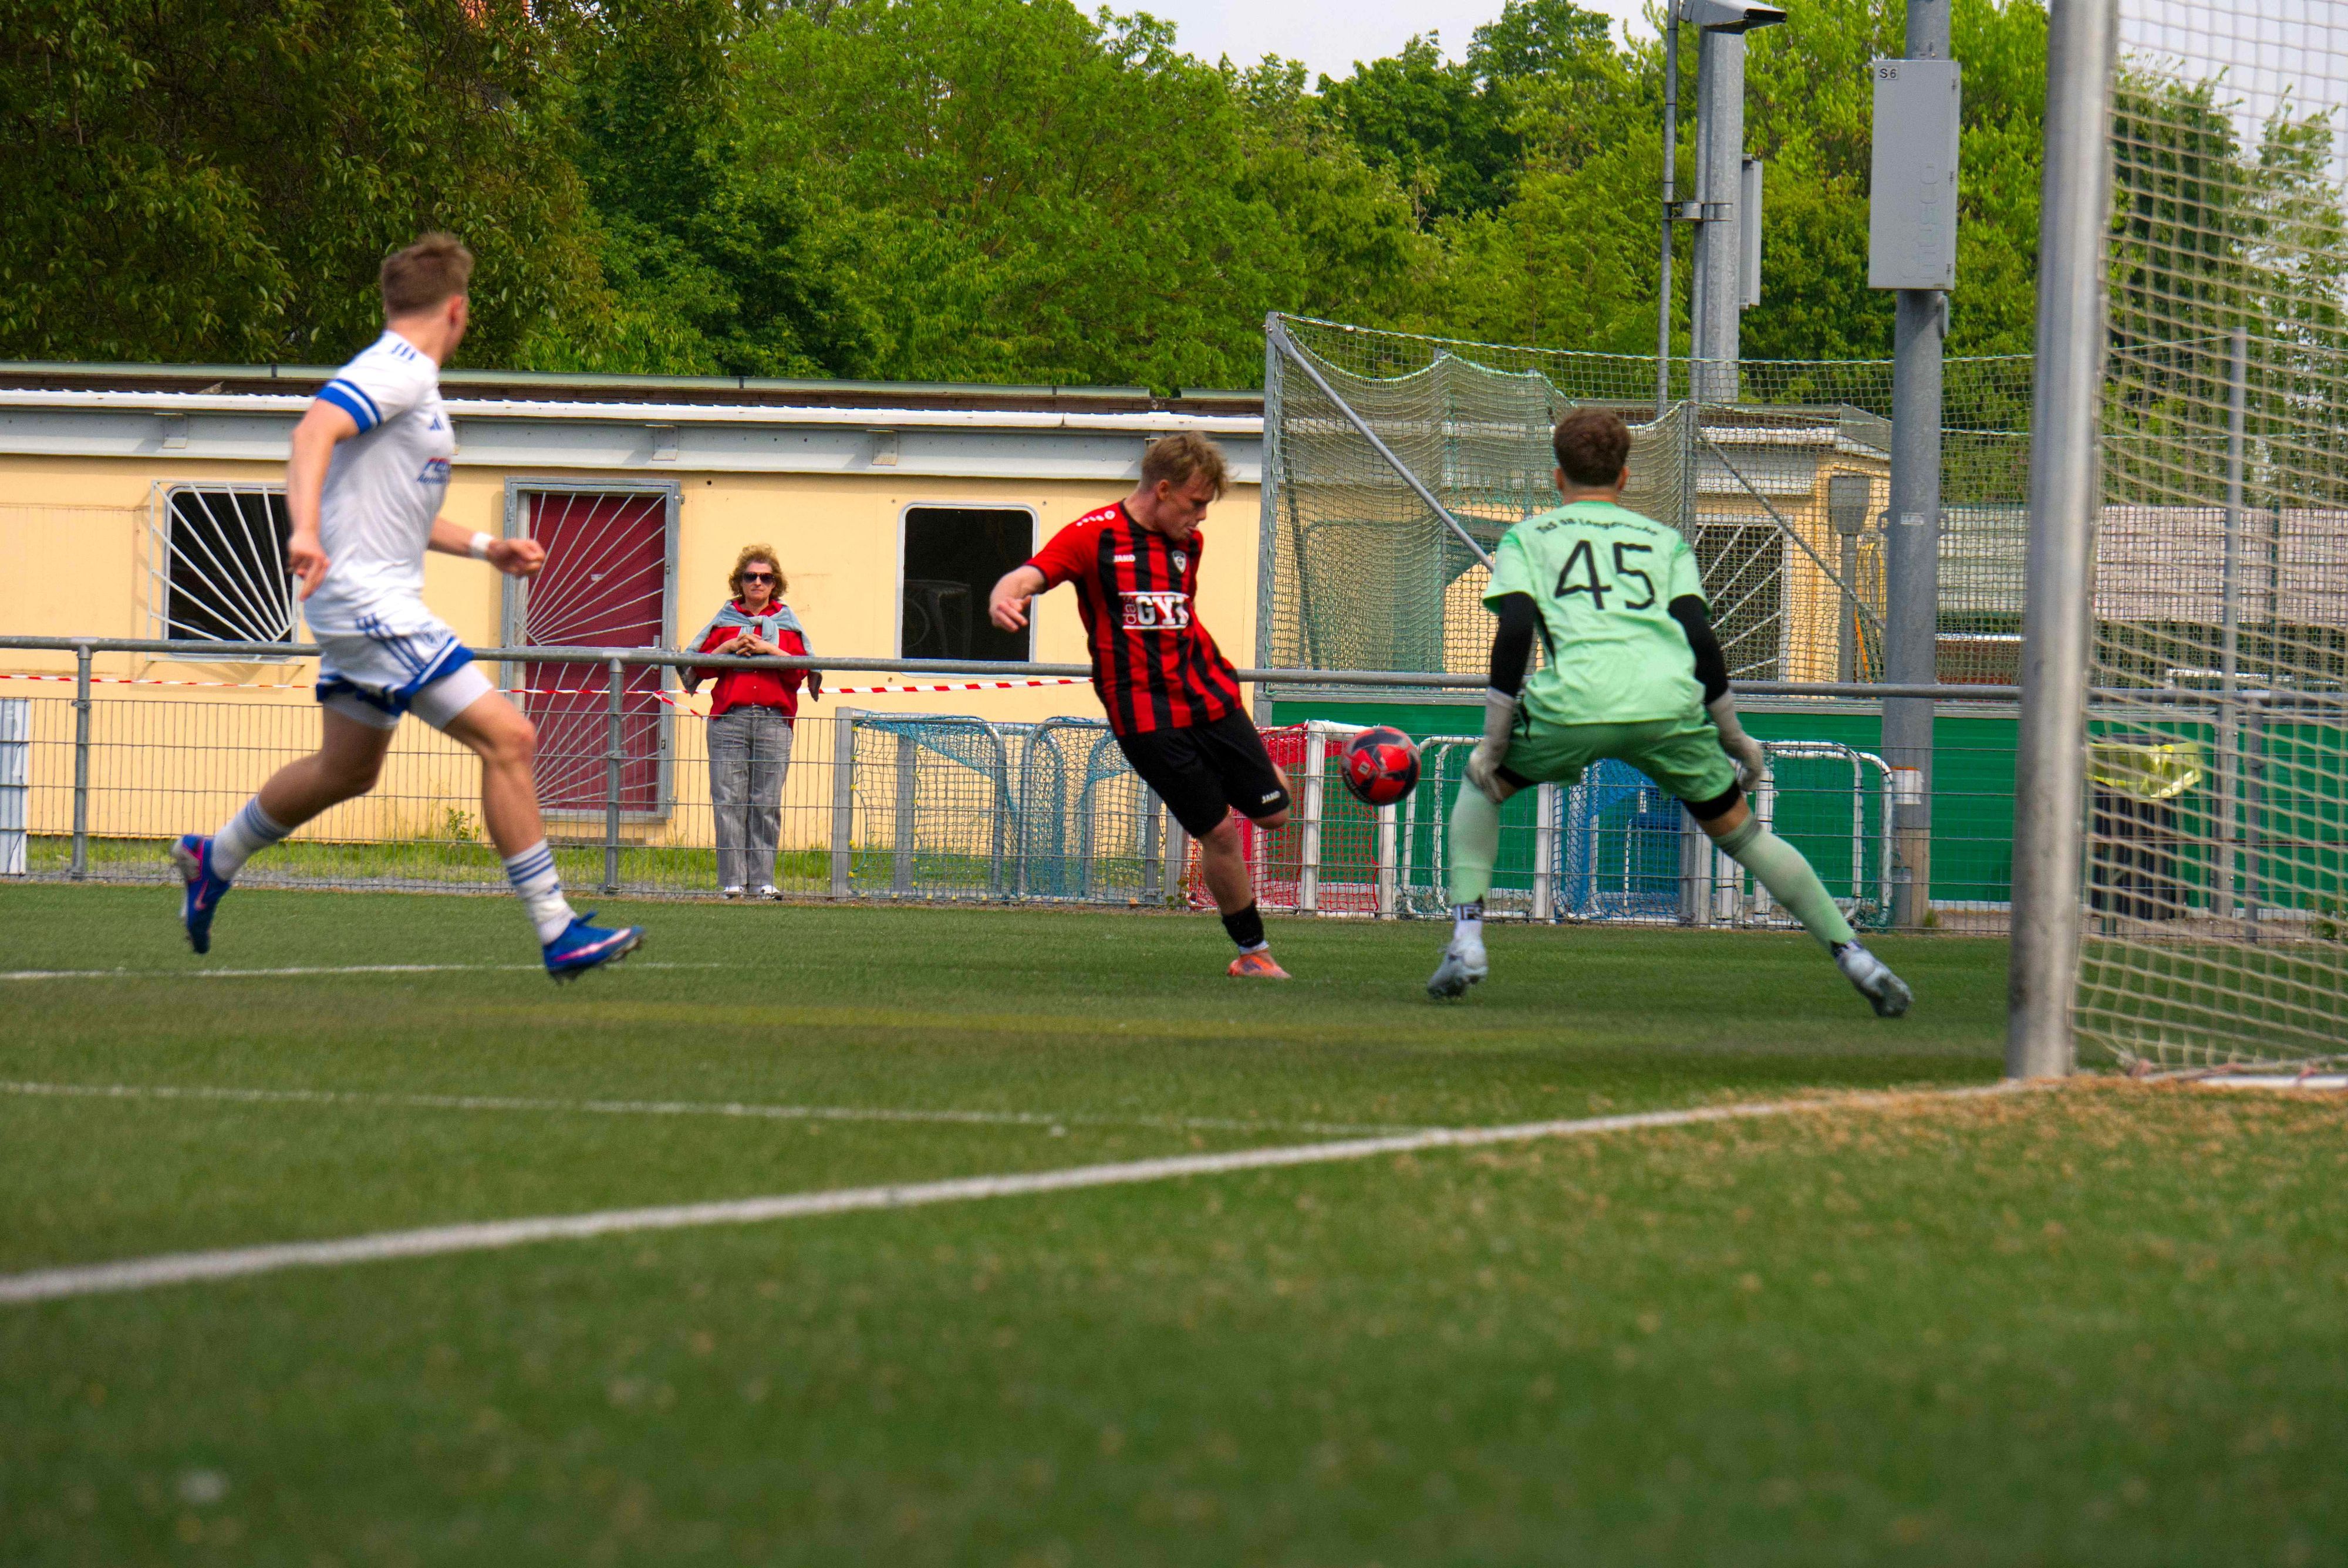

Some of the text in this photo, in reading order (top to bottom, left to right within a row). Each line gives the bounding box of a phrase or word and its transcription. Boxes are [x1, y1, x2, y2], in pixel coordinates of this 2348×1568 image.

[1880, 68, 1897, 79] S6
[1114, 554, 1136, 563] JAKO
[1554, 540, 1656, 610] 45
[1122, 596, 1137, 624] das
[1261, 790, 1281, 805] JAKO
